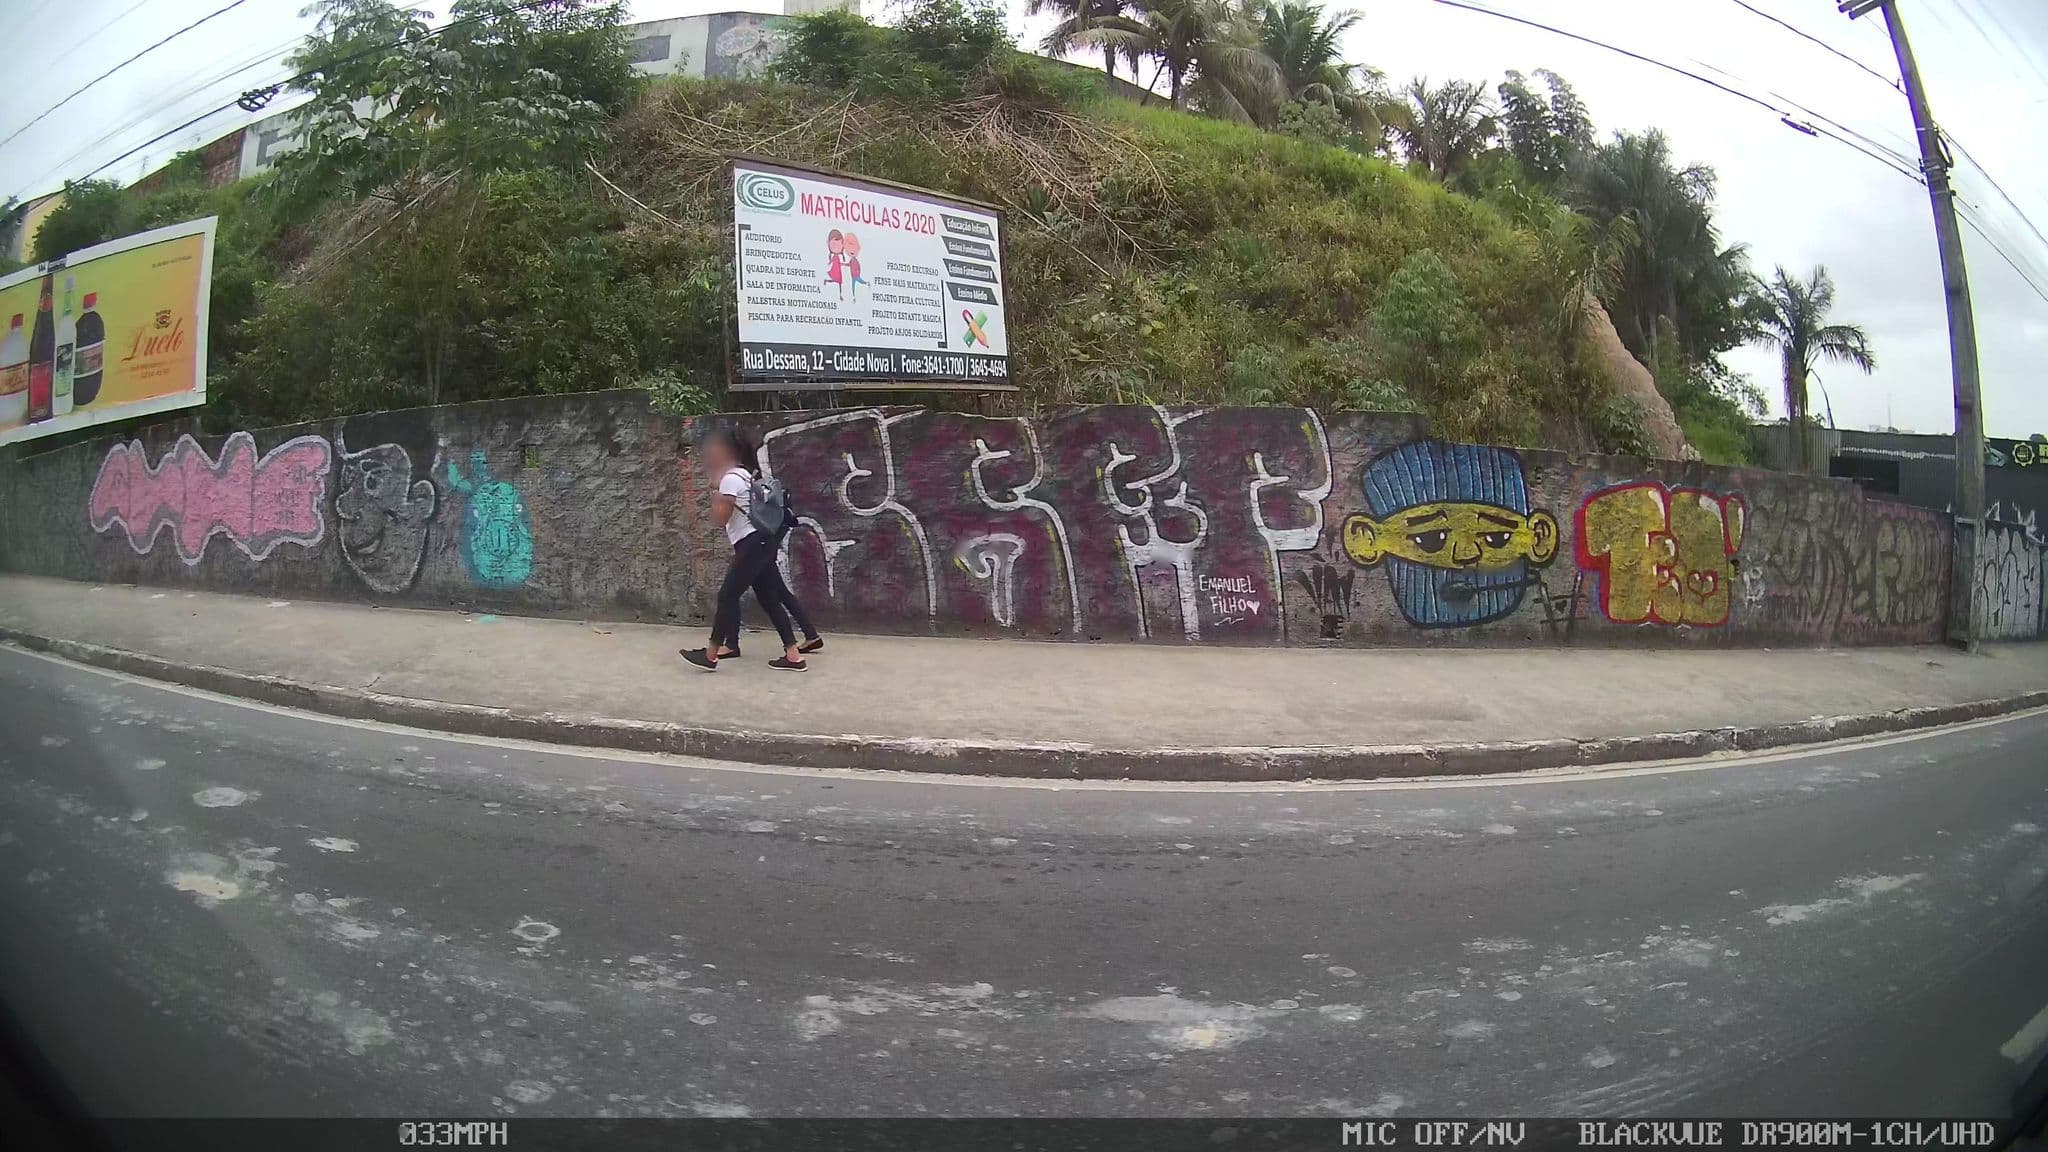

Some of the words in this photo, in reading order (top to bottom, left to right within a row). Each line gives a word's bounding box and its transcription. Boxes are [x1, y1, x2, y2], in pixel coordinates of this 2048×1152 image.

[756, 187, 785, 200] CELUS
[801, 193, 900, 229] MATRÍCULAS
[904, 211, 936, 235] 2020
[745, 248, 802, 261] BRINQUEDOTECA
[746, 264, 774, 274] QUADRA
[776, 266, 785, 275] DE
[787, 268, 816, 278] ESPORTE
[887, 261, 911, 272] PROJETO
[746, 280, 764, 289] SALA
[765, 281, 775, 290] DE
[747, 296, 786, 306] PALESTRAS
[787, 299, 837, 310] MOTIVACIONAIS
[872, 292, 897, 303] PROJETO
[748, 312, 775, 321] PISCINA
[776, 314, 794, 323] PARA
[835, 317, 863, 327] INFANTIL
[871, 309, 897, 320] PROJETO
[868, 326, 894, 336] PROJETO
[743, 348, 764, 370] Rua
[766, 348, 810, 374] Dessana,
[812, 350, 825, 371] 12
[833, 350, 865, 372] Cidade
[866, 352, 890, 373] Nova
[1199, 574, 1257, 596] EMANUEL
